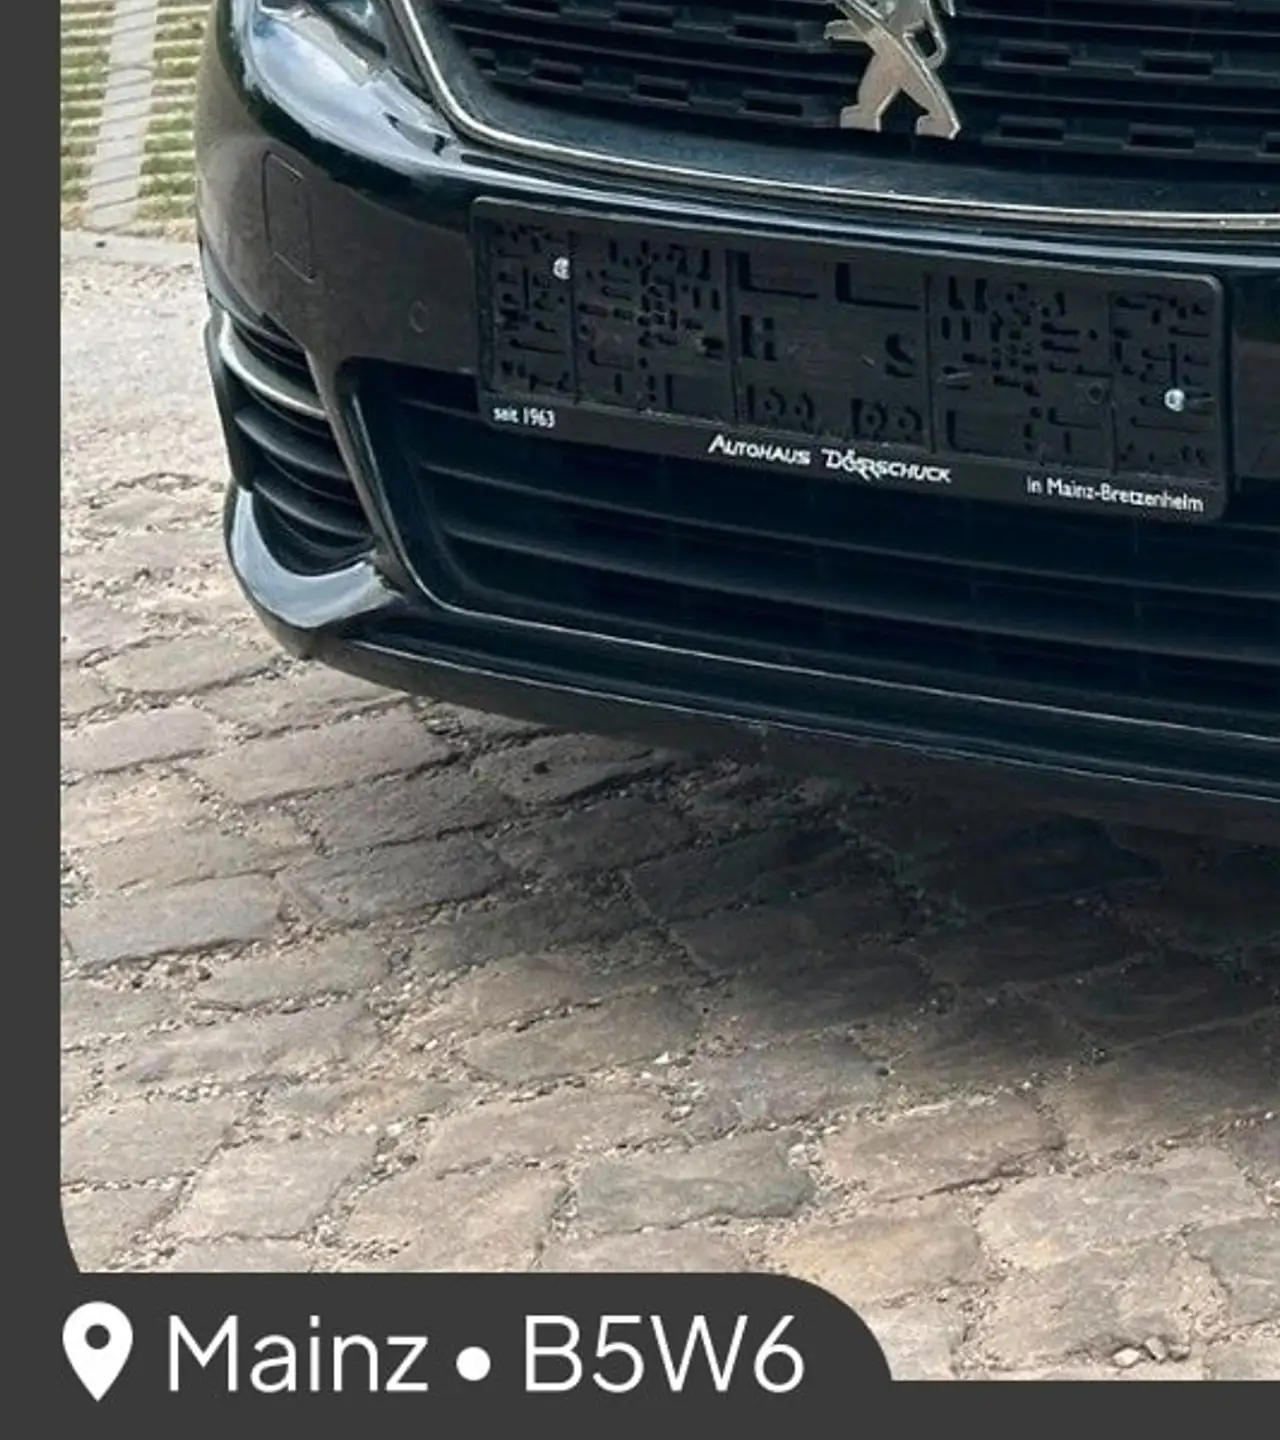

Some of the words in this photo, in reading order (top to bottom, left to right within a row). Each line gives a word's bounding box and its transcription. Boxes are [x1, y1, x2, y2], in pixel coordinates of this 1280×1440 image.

[493, 405, 519, 423] seit
[523, 406, 556, 429] 1963
[1026, 476, 1043, 495] in
[1046, 477, 1204, 513] Mainz-Bretzenheim
